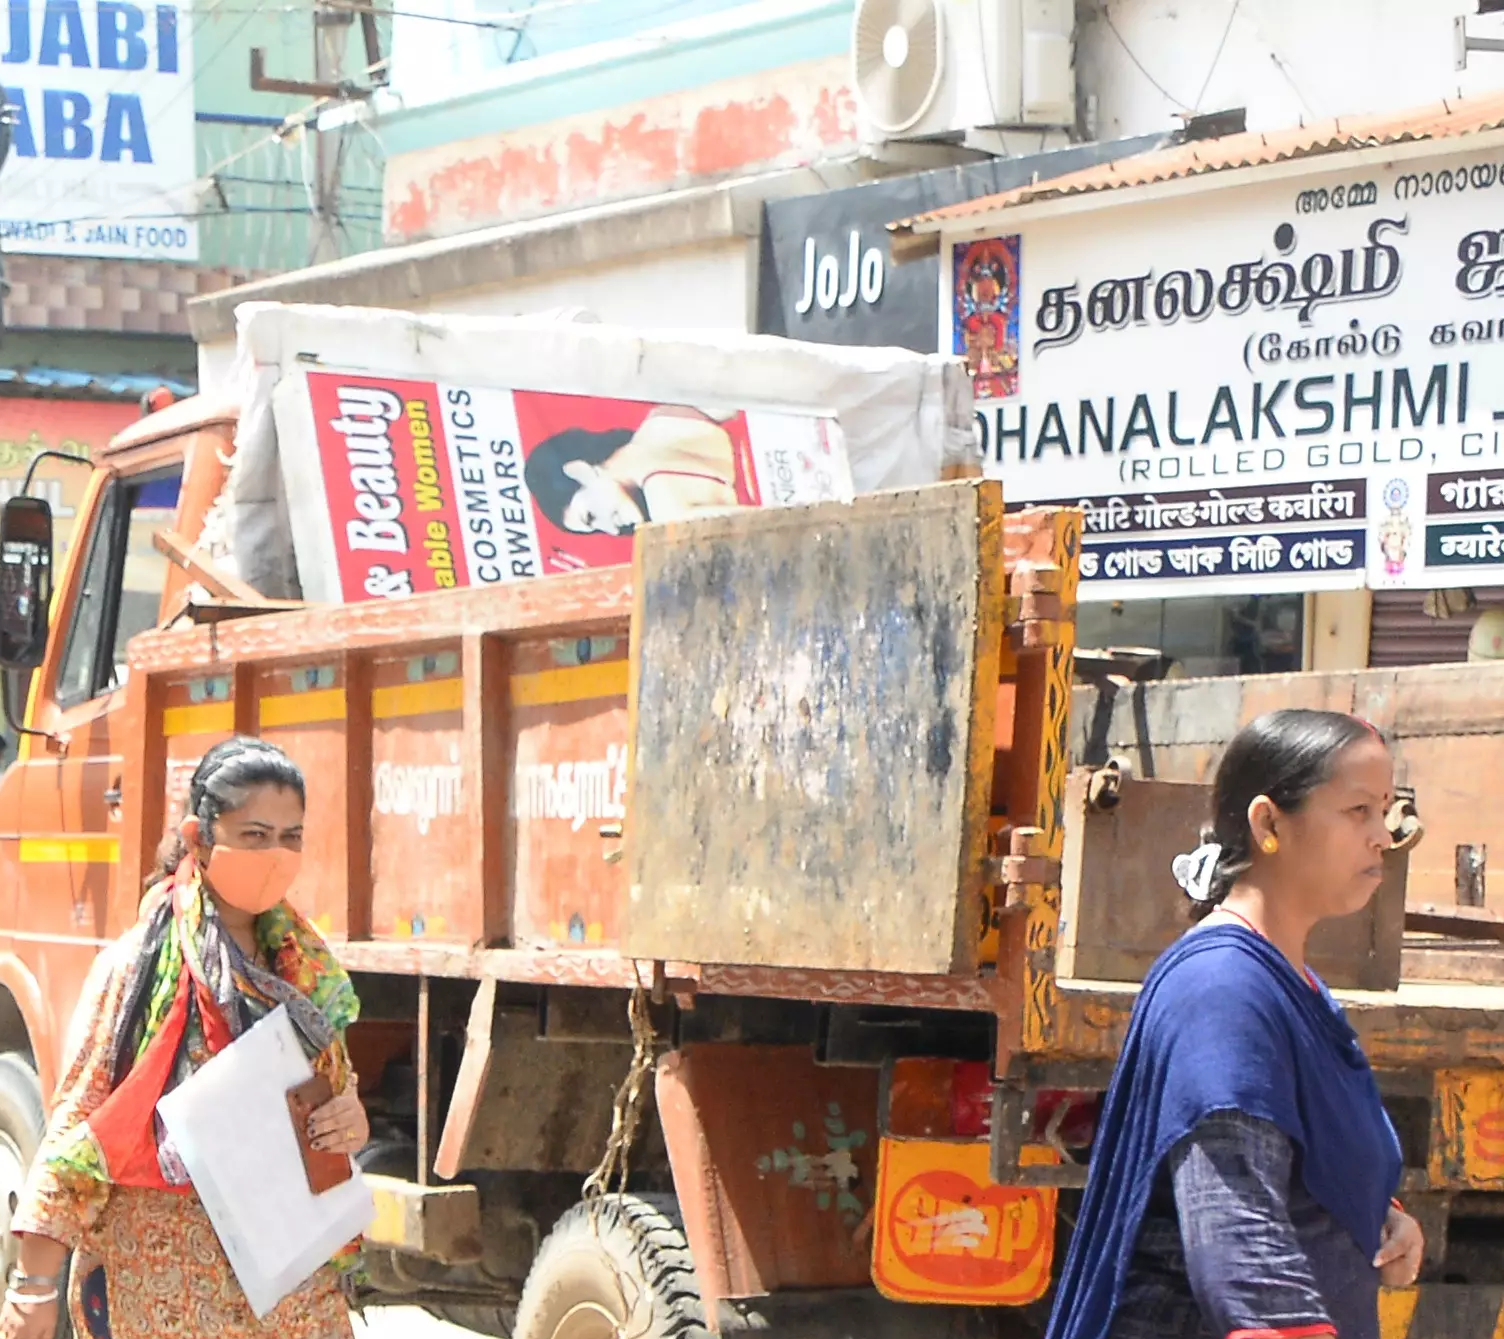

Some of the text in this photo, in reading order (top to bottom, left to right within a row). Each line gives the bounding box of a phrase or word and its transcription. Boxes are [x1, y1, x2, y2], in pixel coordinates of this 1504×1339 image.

[135, 226, 189, 248] FOOD
[795, 230, 884, 314] JoJo
[329, 385, 410, 555] Beauty
[405, 399, 444, 512] Women
[448, 389, 501, 583] COSMETICS
[491, 439, 535, 577] RWEARS
[1119, 448, 1286, 484] (ROLLED
[1307, 435, 1439, 469] GOLD,
